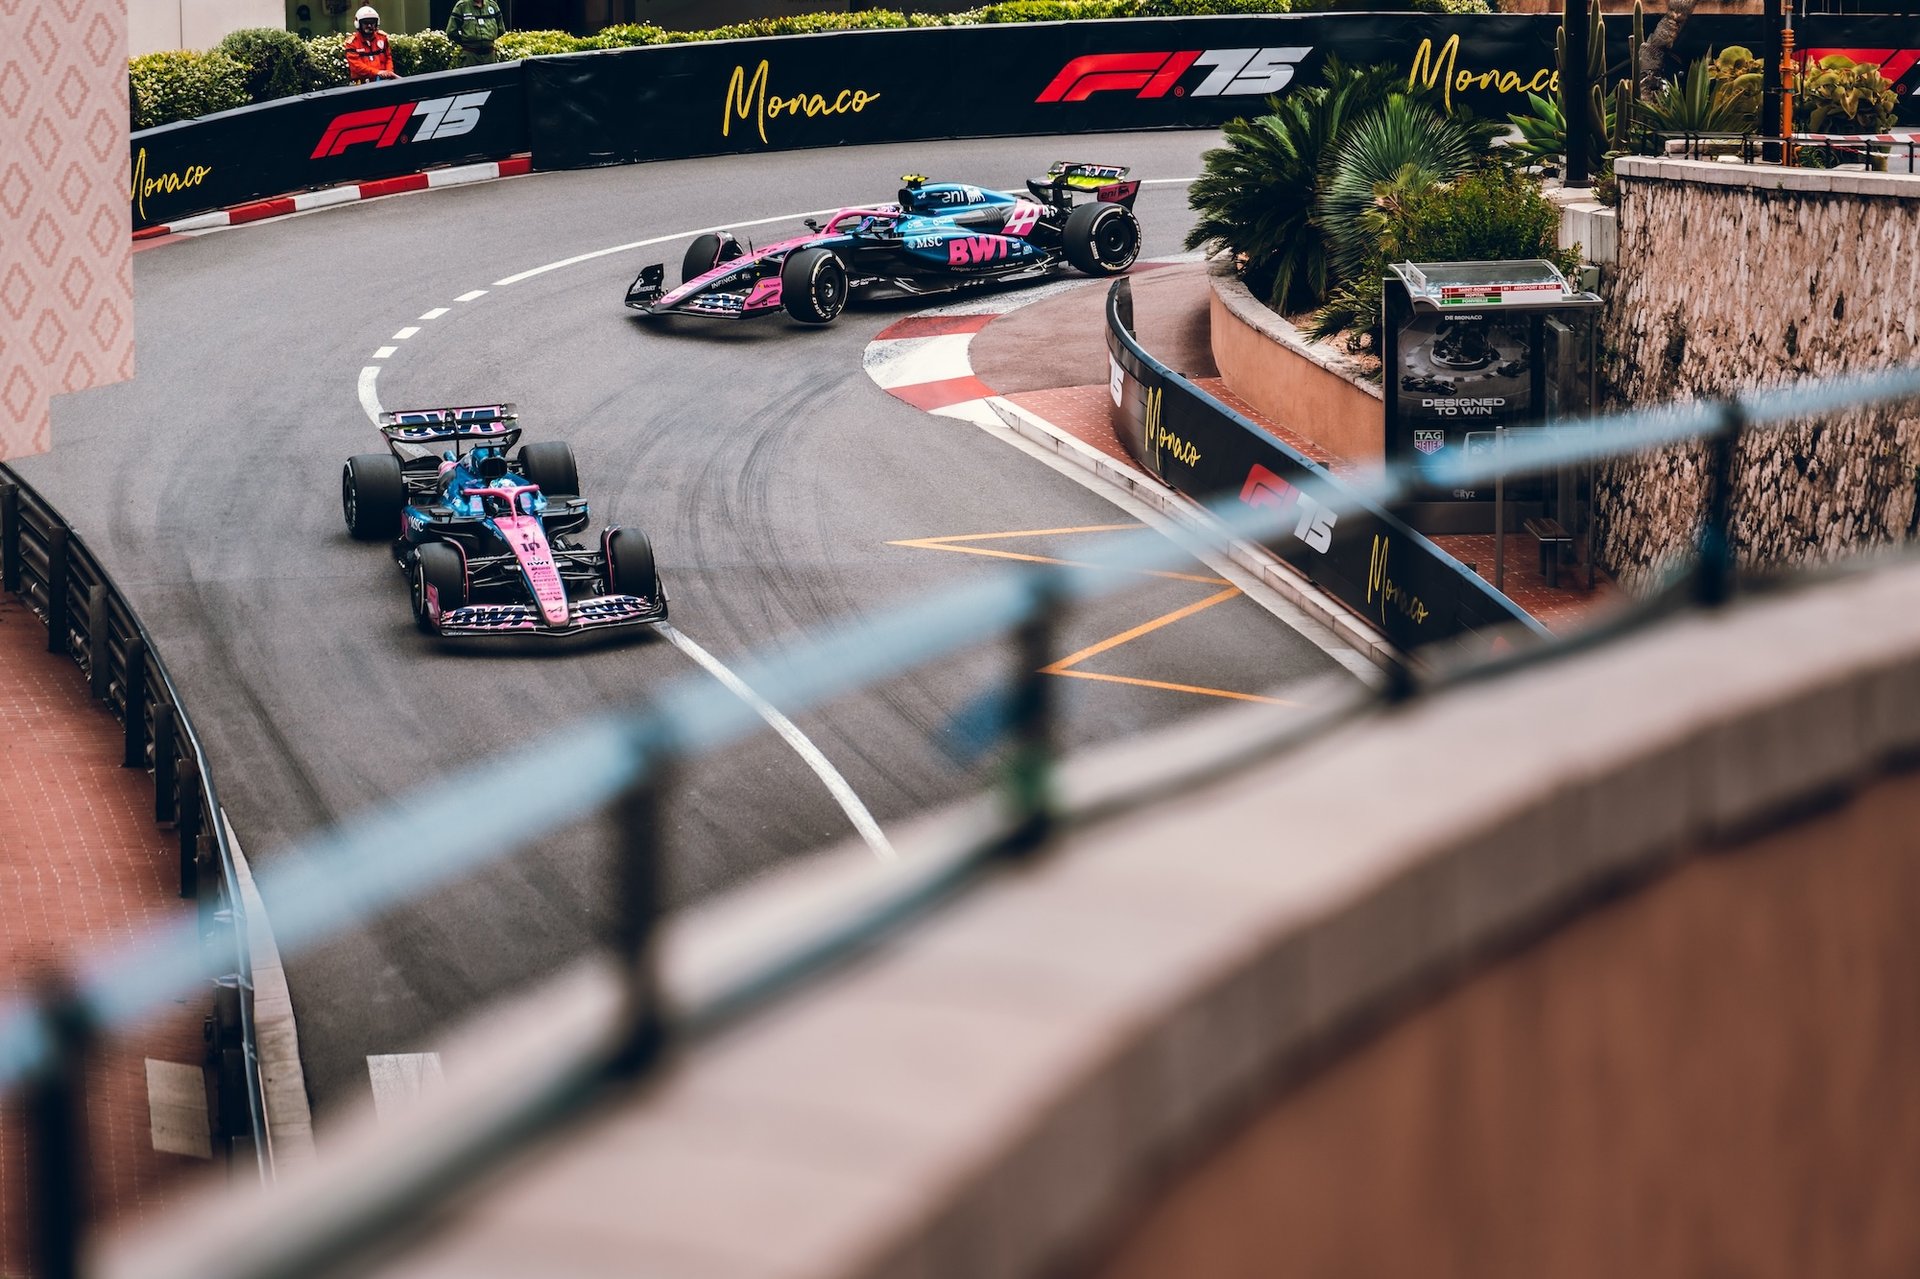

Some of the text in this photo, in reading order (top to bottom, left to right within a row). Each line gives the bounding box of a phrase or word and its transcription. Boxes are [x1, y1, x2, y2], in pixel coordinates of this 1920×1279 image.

[723, 59, 881, 144] Monaco
[916, 235, 944, 249] MSC
[947, 235, 1008, 266] BWT
[711, 273, 738, 290] INFINOX
[1422, 397, 1506, 408] DESIGNED
[1434, 406, 1493, 416] TO WIN
[1145, 386, 1202, 471] Monaco
[1417, 432, 1442, 440] TAG
